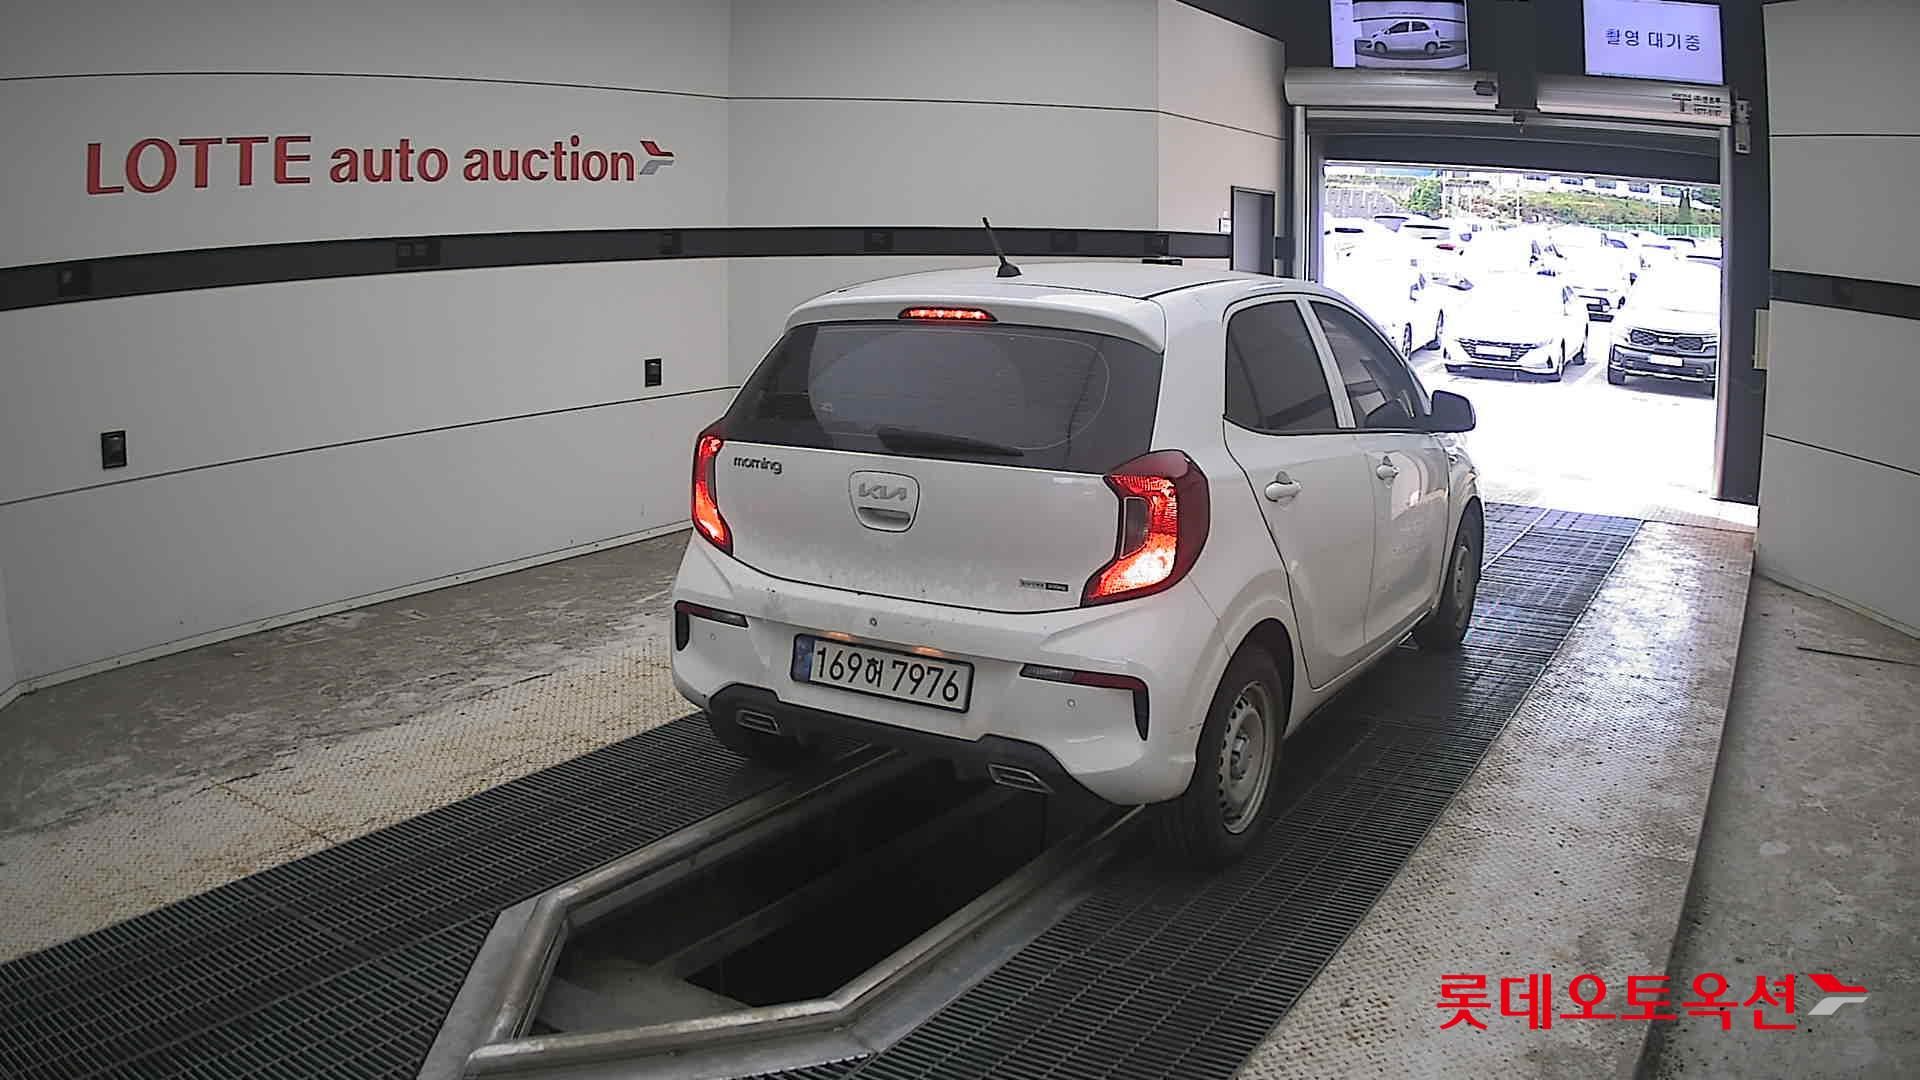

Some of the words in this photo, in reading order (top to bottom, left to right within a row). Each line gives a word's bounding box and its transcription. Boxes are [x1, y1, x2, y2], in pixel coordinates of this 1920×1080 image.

[1648, 31, 1701, 51] 대기중
[86, 136, 311, 194] LOTTE
[329, 139, 448, 183] auto
[463, 135, 635, 181] auction
[733, 456, 782, 474] morning
[858, 482, 907, 500] KIA
[892, 661, 959, 702] 7976
